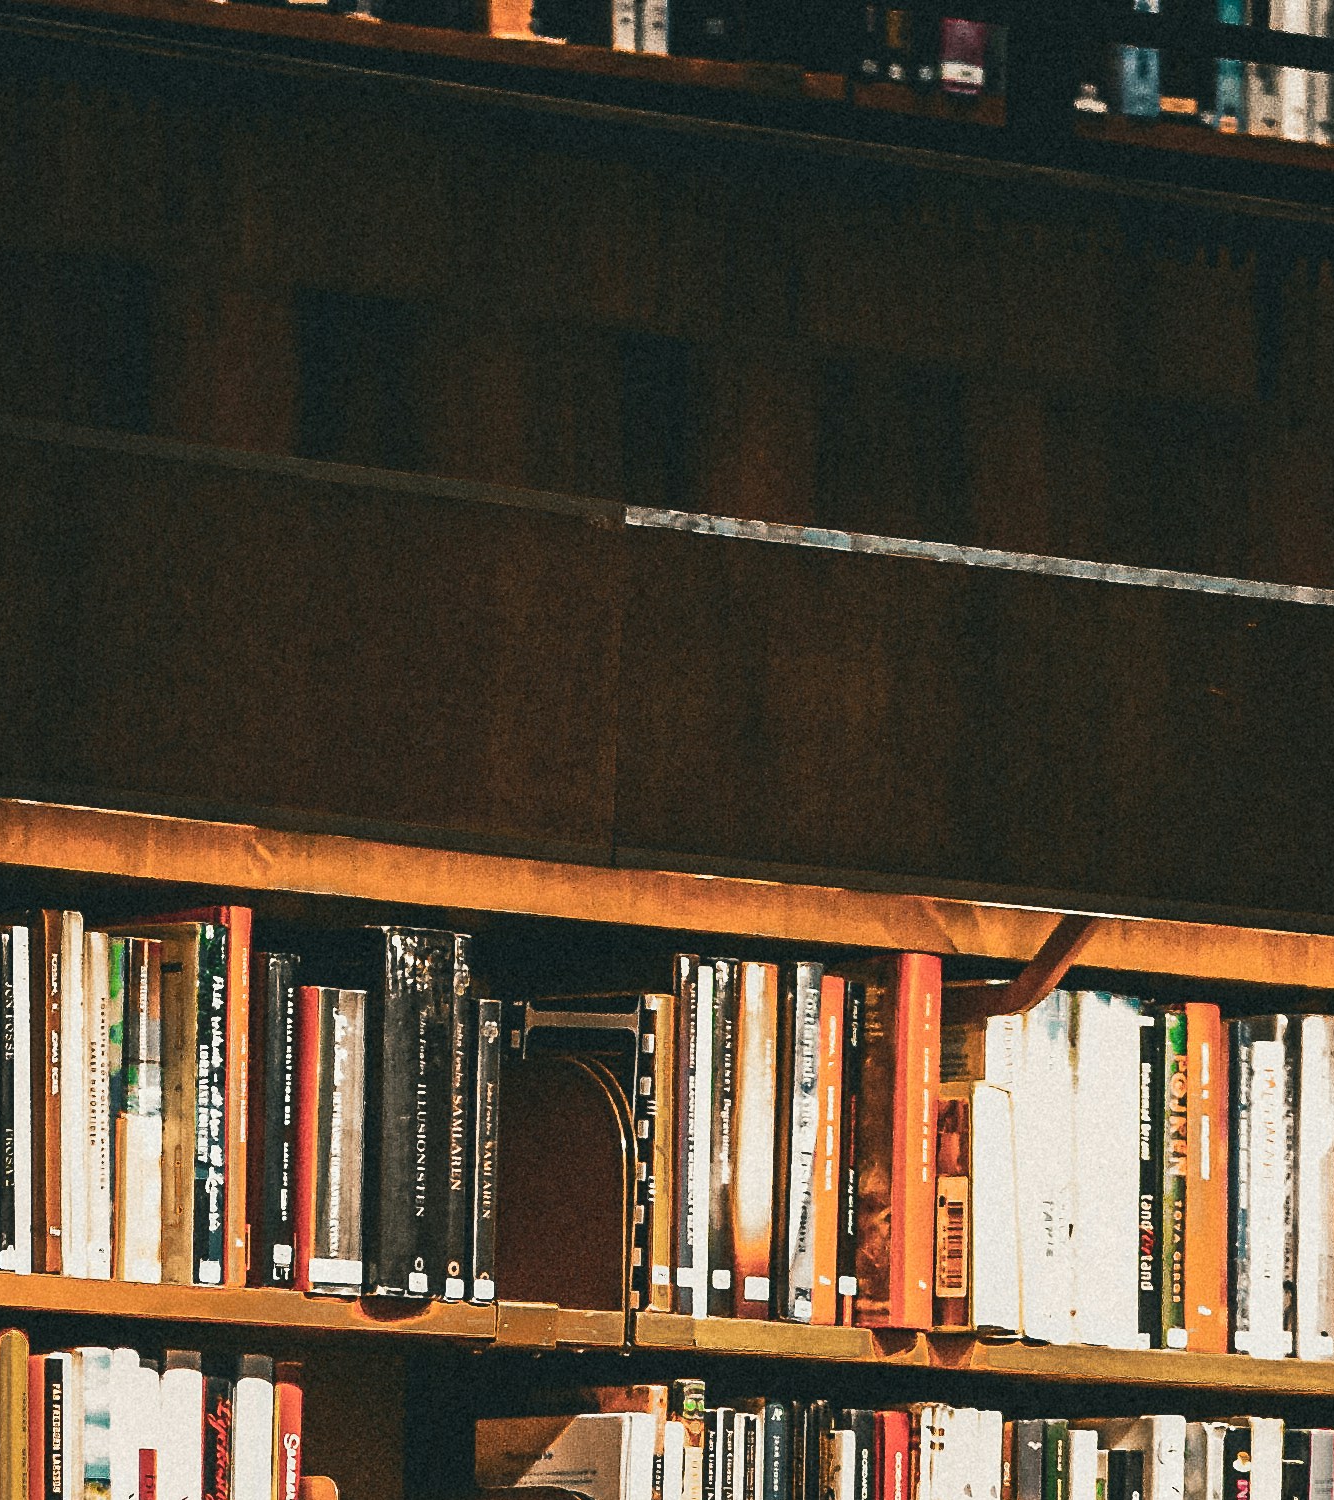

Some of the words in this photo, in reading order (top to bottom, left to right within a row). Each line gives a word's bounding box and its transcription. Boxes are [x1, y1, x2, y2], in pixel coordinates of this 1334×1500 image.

[415, 1083, 427, 1217] ILLUSIONISTEN
[450, 1094, 463, 1190] SAMLAREN
[1170, 1055, 1186, 1175] POJKEN
